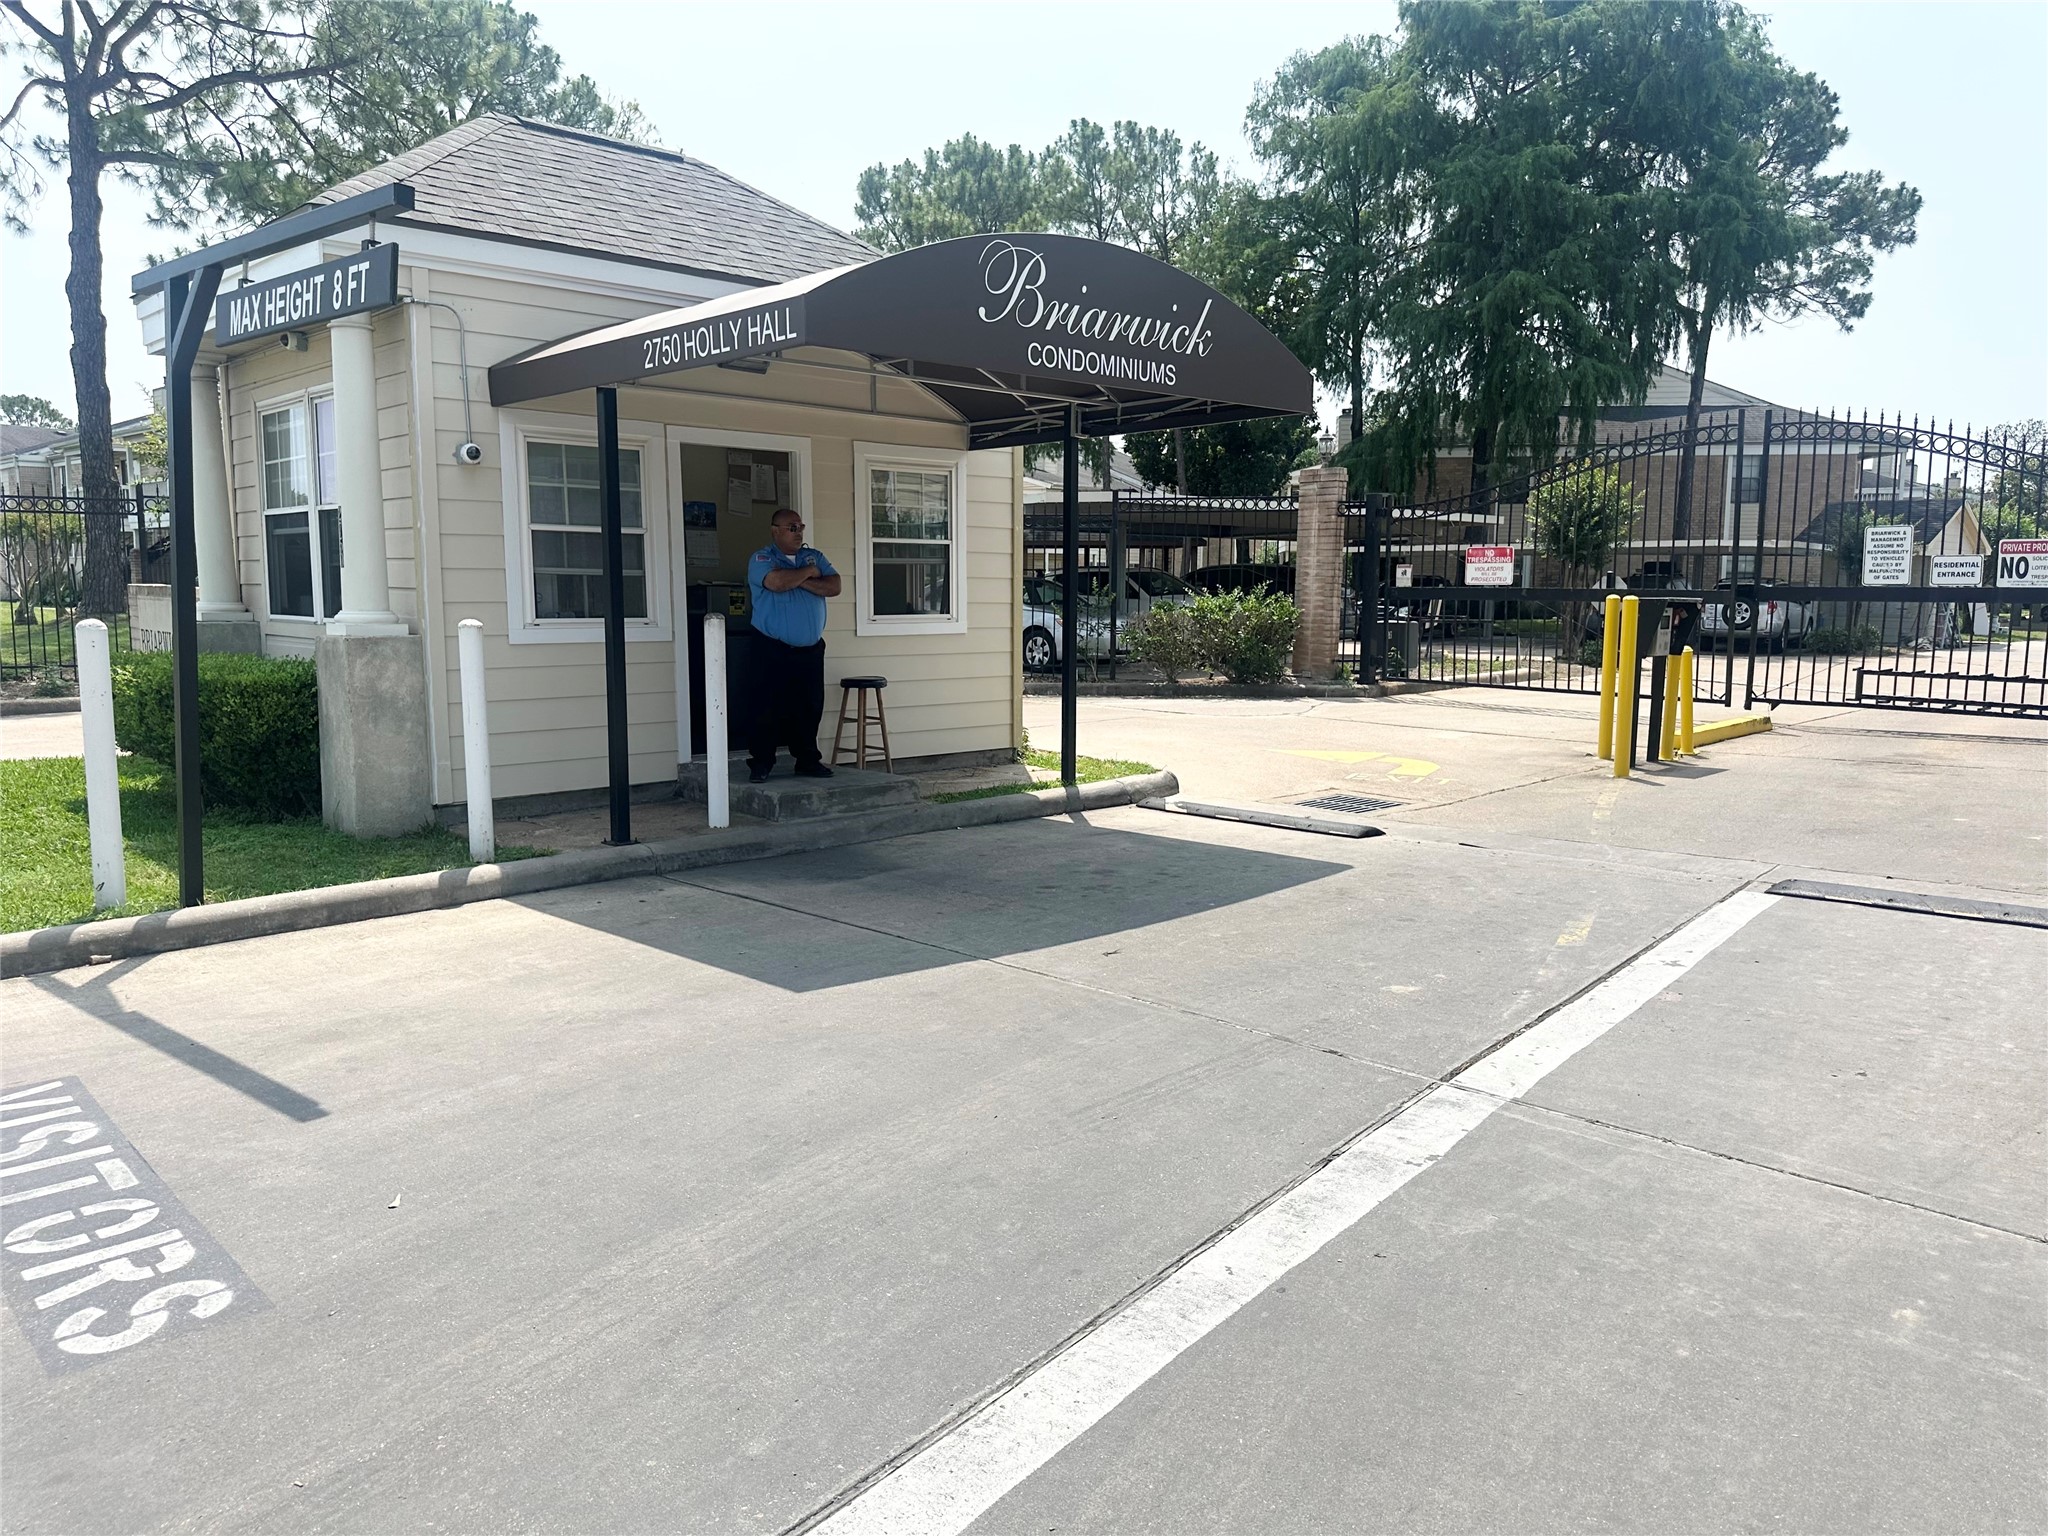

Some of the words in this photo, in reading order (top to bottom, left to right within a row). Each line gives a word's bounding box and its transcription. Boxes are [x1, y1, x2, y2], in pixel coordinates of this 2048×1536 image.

[230, 292, 262, 337] MAX
[265, 273, 325, 328] HEIGHT
[332, 268, 343, 311] 8
[347, 260, 370, 307] FT
[978, 239, 1214, 357] Briarwick
[643, 332, 681, 369] 2750
[684, 317, 743, 361] HOLLY
[748, 306, 798, 348] HALL
[1027, 341, 1177, 387] CONDOMINIUMS
[1484, 549, 1495, 557] NO
[2000, 556, 2029, 579] NO
[2002, 543, 2032, 552] PRIVATE
